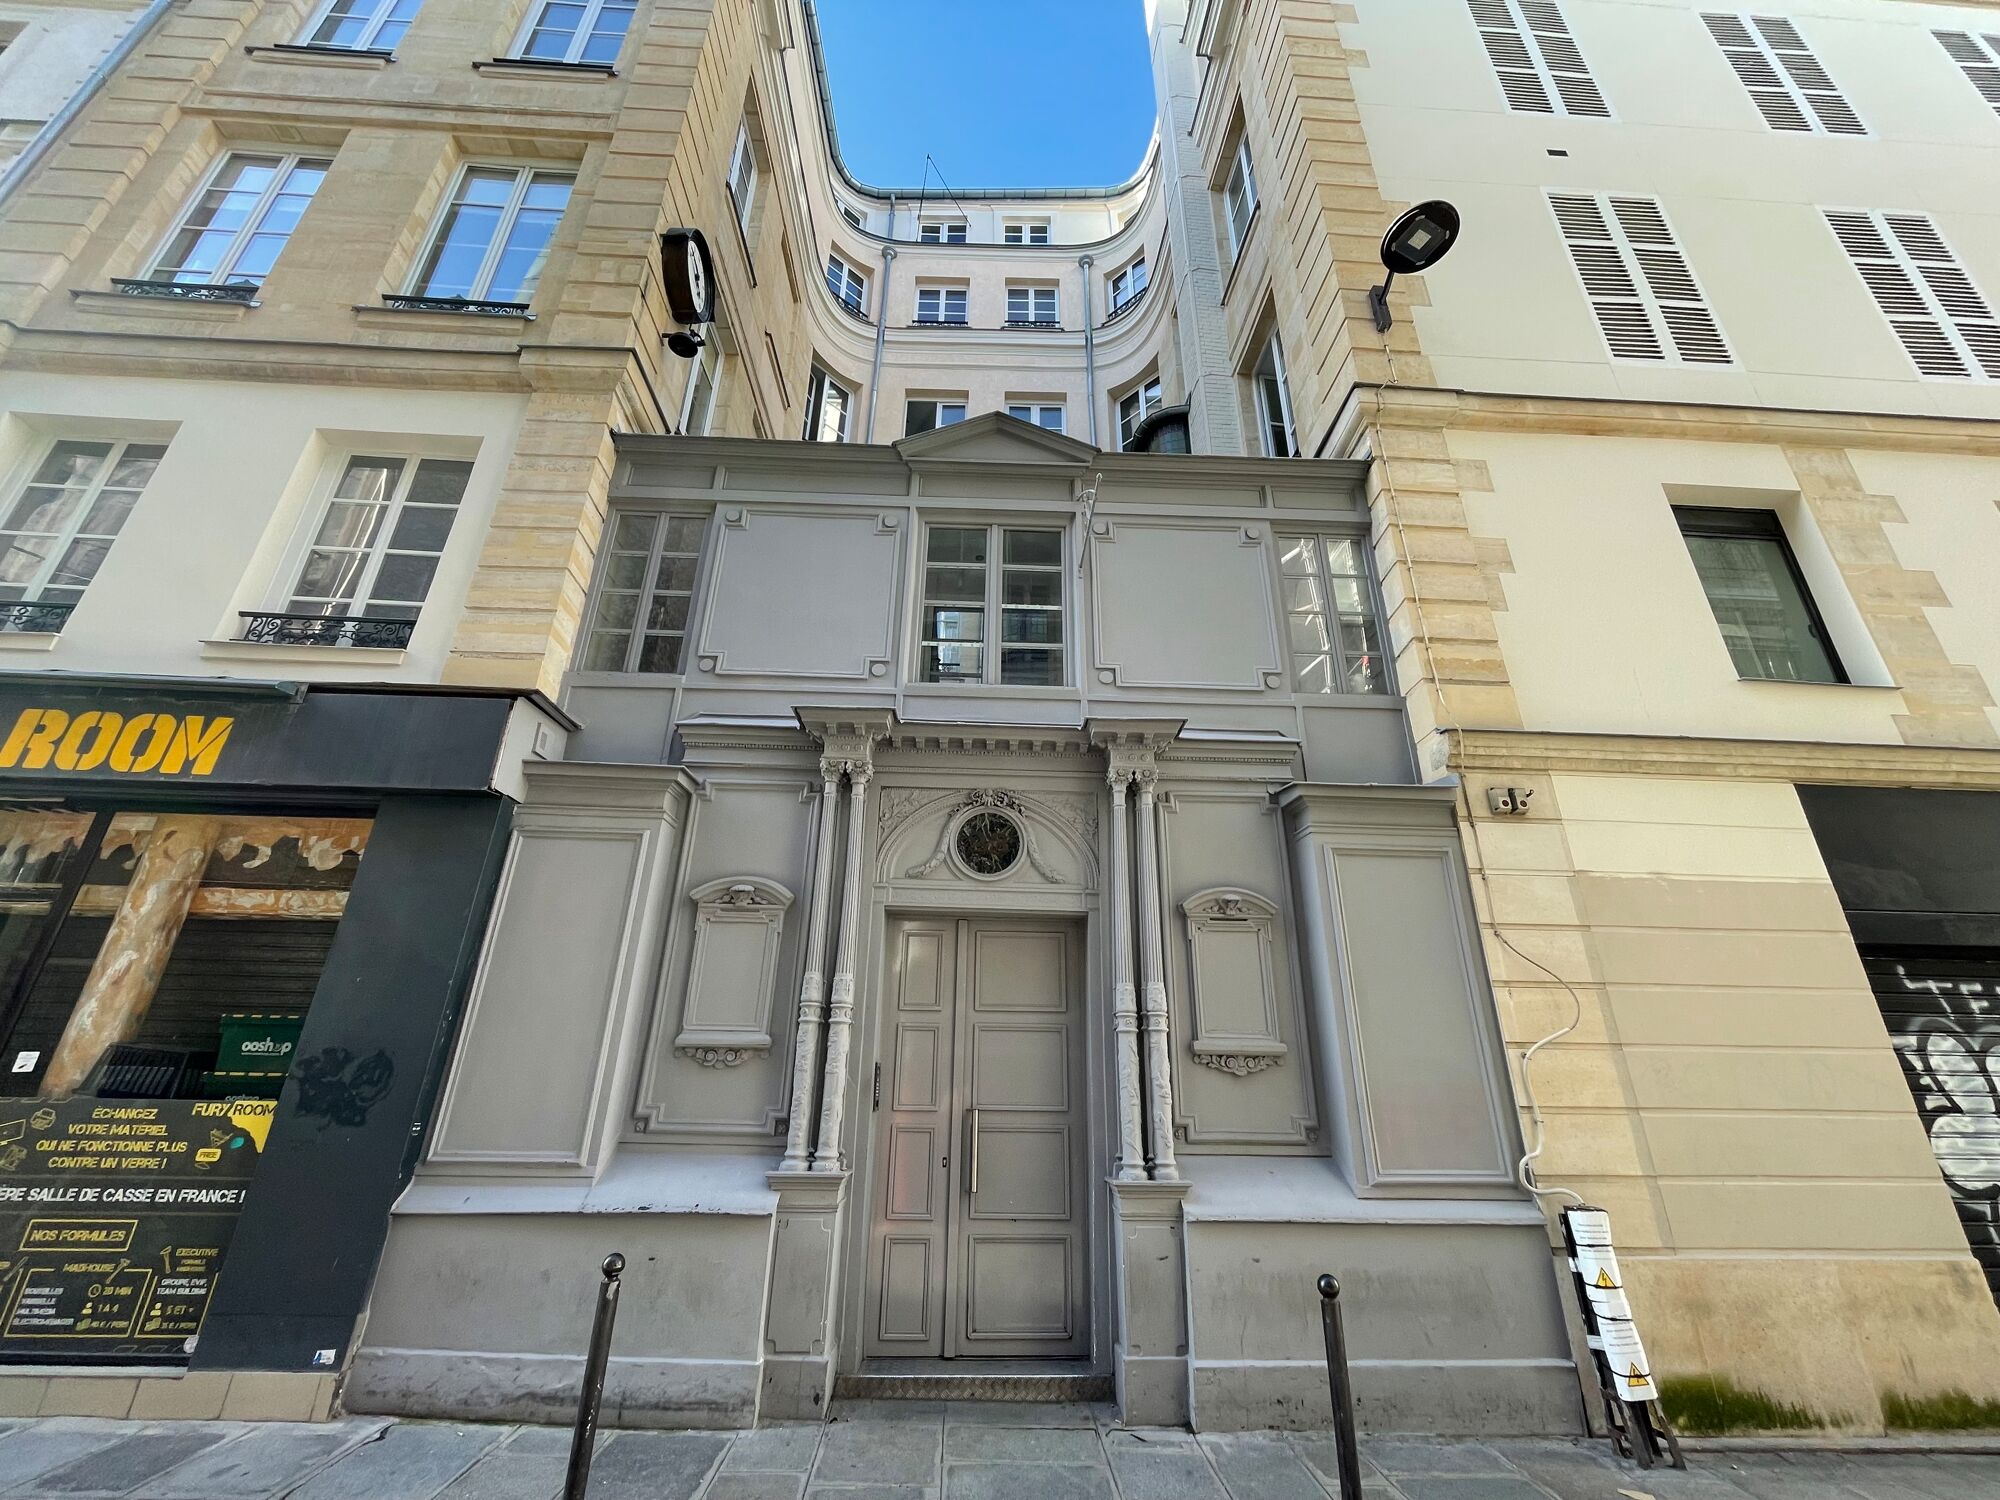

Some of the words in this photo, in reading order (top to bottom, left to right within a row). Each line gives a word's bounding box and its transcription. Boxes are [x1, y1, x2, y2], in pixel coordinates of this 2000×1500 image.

[0, 708, 235, 775] ROOM
[68, 1124, 108, 1135] VOTRE
[36, 1140, 58, 1151] QUI
[59, 1141, 77, 1151] NE
[77, 1141, 156, 1152] FONCTIONNE
[156, 1142, 188, 1152] PLUS
[48, 1157, 99, 1168] CONTRE
[100, 1158, 118, 1168] UN
[121, 1158, 161, 1169] VERRE
[27, 1187, 79, 1201] SALLE
[78, 1188, 101, 1202] DE
[103, 1188, 154, 1202] CASSE
[155, 1189, 178, 1203] EN
[178, 1189, 239, 1203] FRANCE
[30, 1229, 59, 1242] NOS
[59, 1230, 127, 1242] FORMULES
